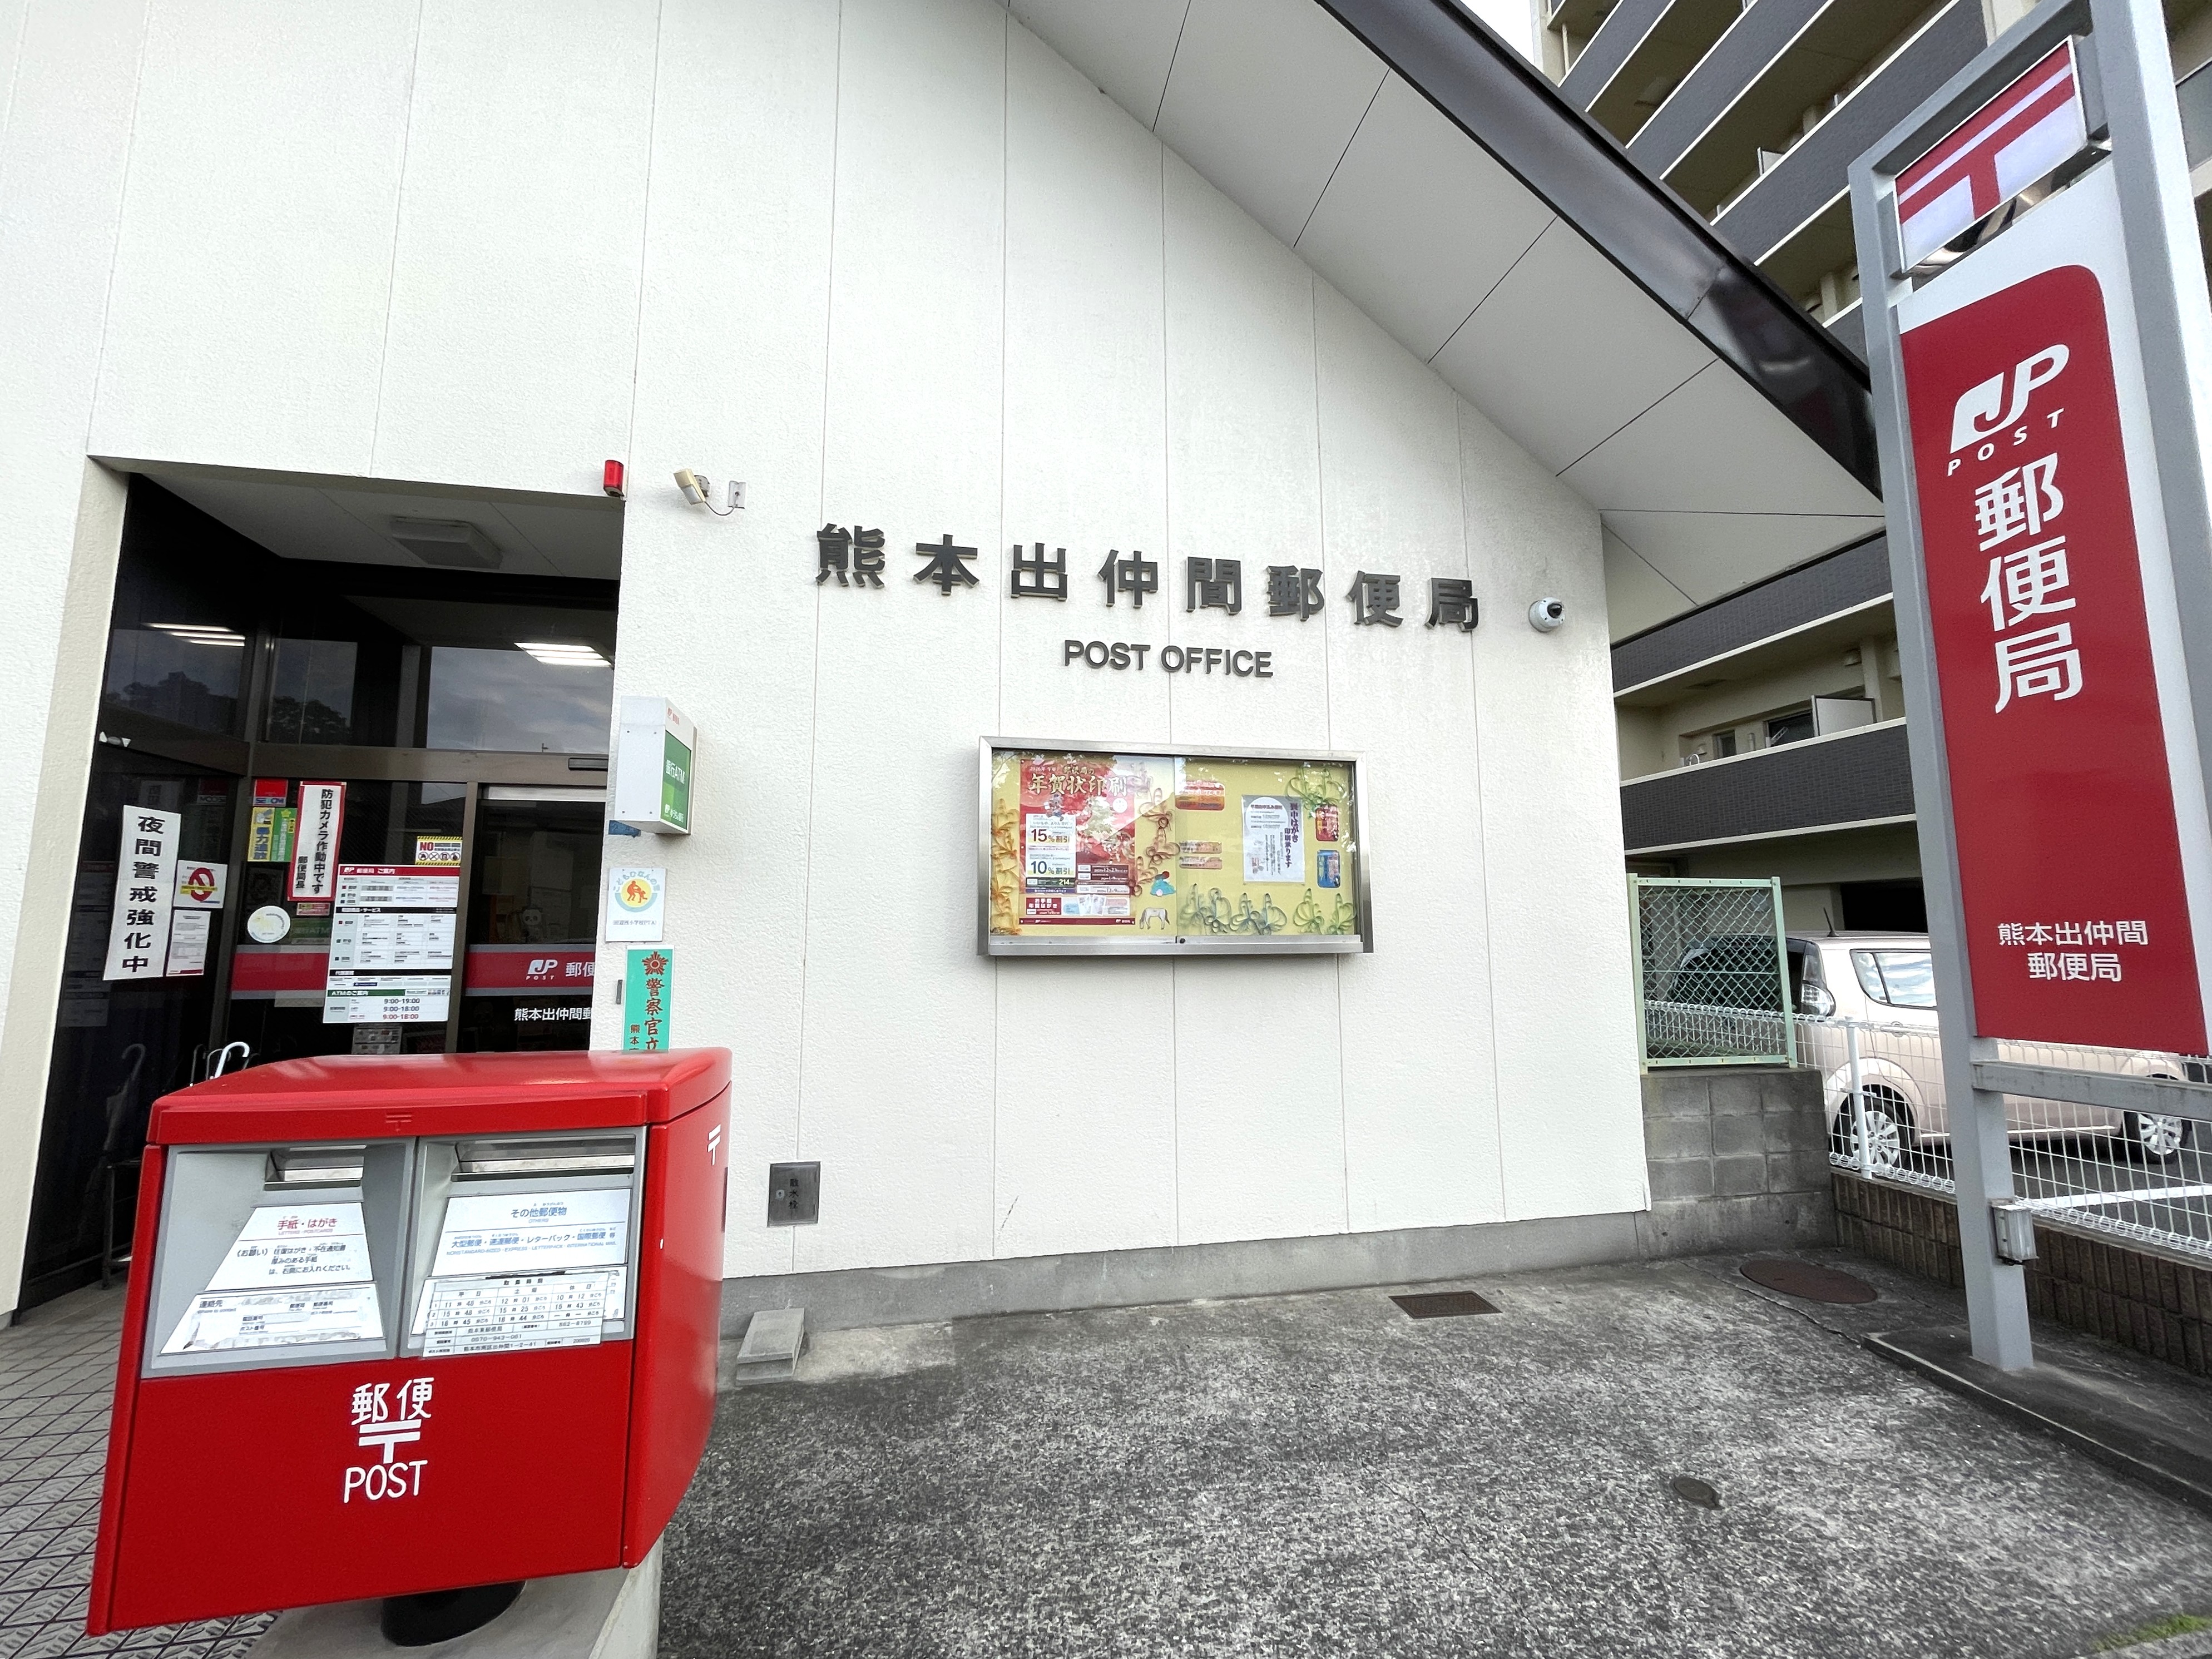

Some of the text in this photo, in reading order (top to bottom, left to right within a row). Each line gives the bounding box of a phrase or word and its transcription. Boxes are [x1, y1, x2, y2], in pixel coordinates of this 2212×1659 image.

[1948, 409, 2064, 477] POST
[816, 523, 1478, 631] 熊本出仲間郵便局
[1975, 452, 2084, 714] 郵便局
[1063, 640, 1274, 678] POST OFFICE
[1028, 774, 1127, 797] 年賀状印刷
[312, 789, 334, 894] 防犯カメラ作動中です
[420, 842, 434, 851] NO
[122, 816, 166, 973] 夜間警戒強化中
[1997, 920, 2149, 947] 熊本出仲間
[2027, 951, 2122, 982] 郵便局
[630, 1024, 640, 1050] 熊本
[277, 1218, 338, 1230] 手紙・はがき
[511, 1206, 567, 1218] その他郵便物
[351, 1376, 435, 1425] 郵便
[343, 1459, 428, 1503] POST
